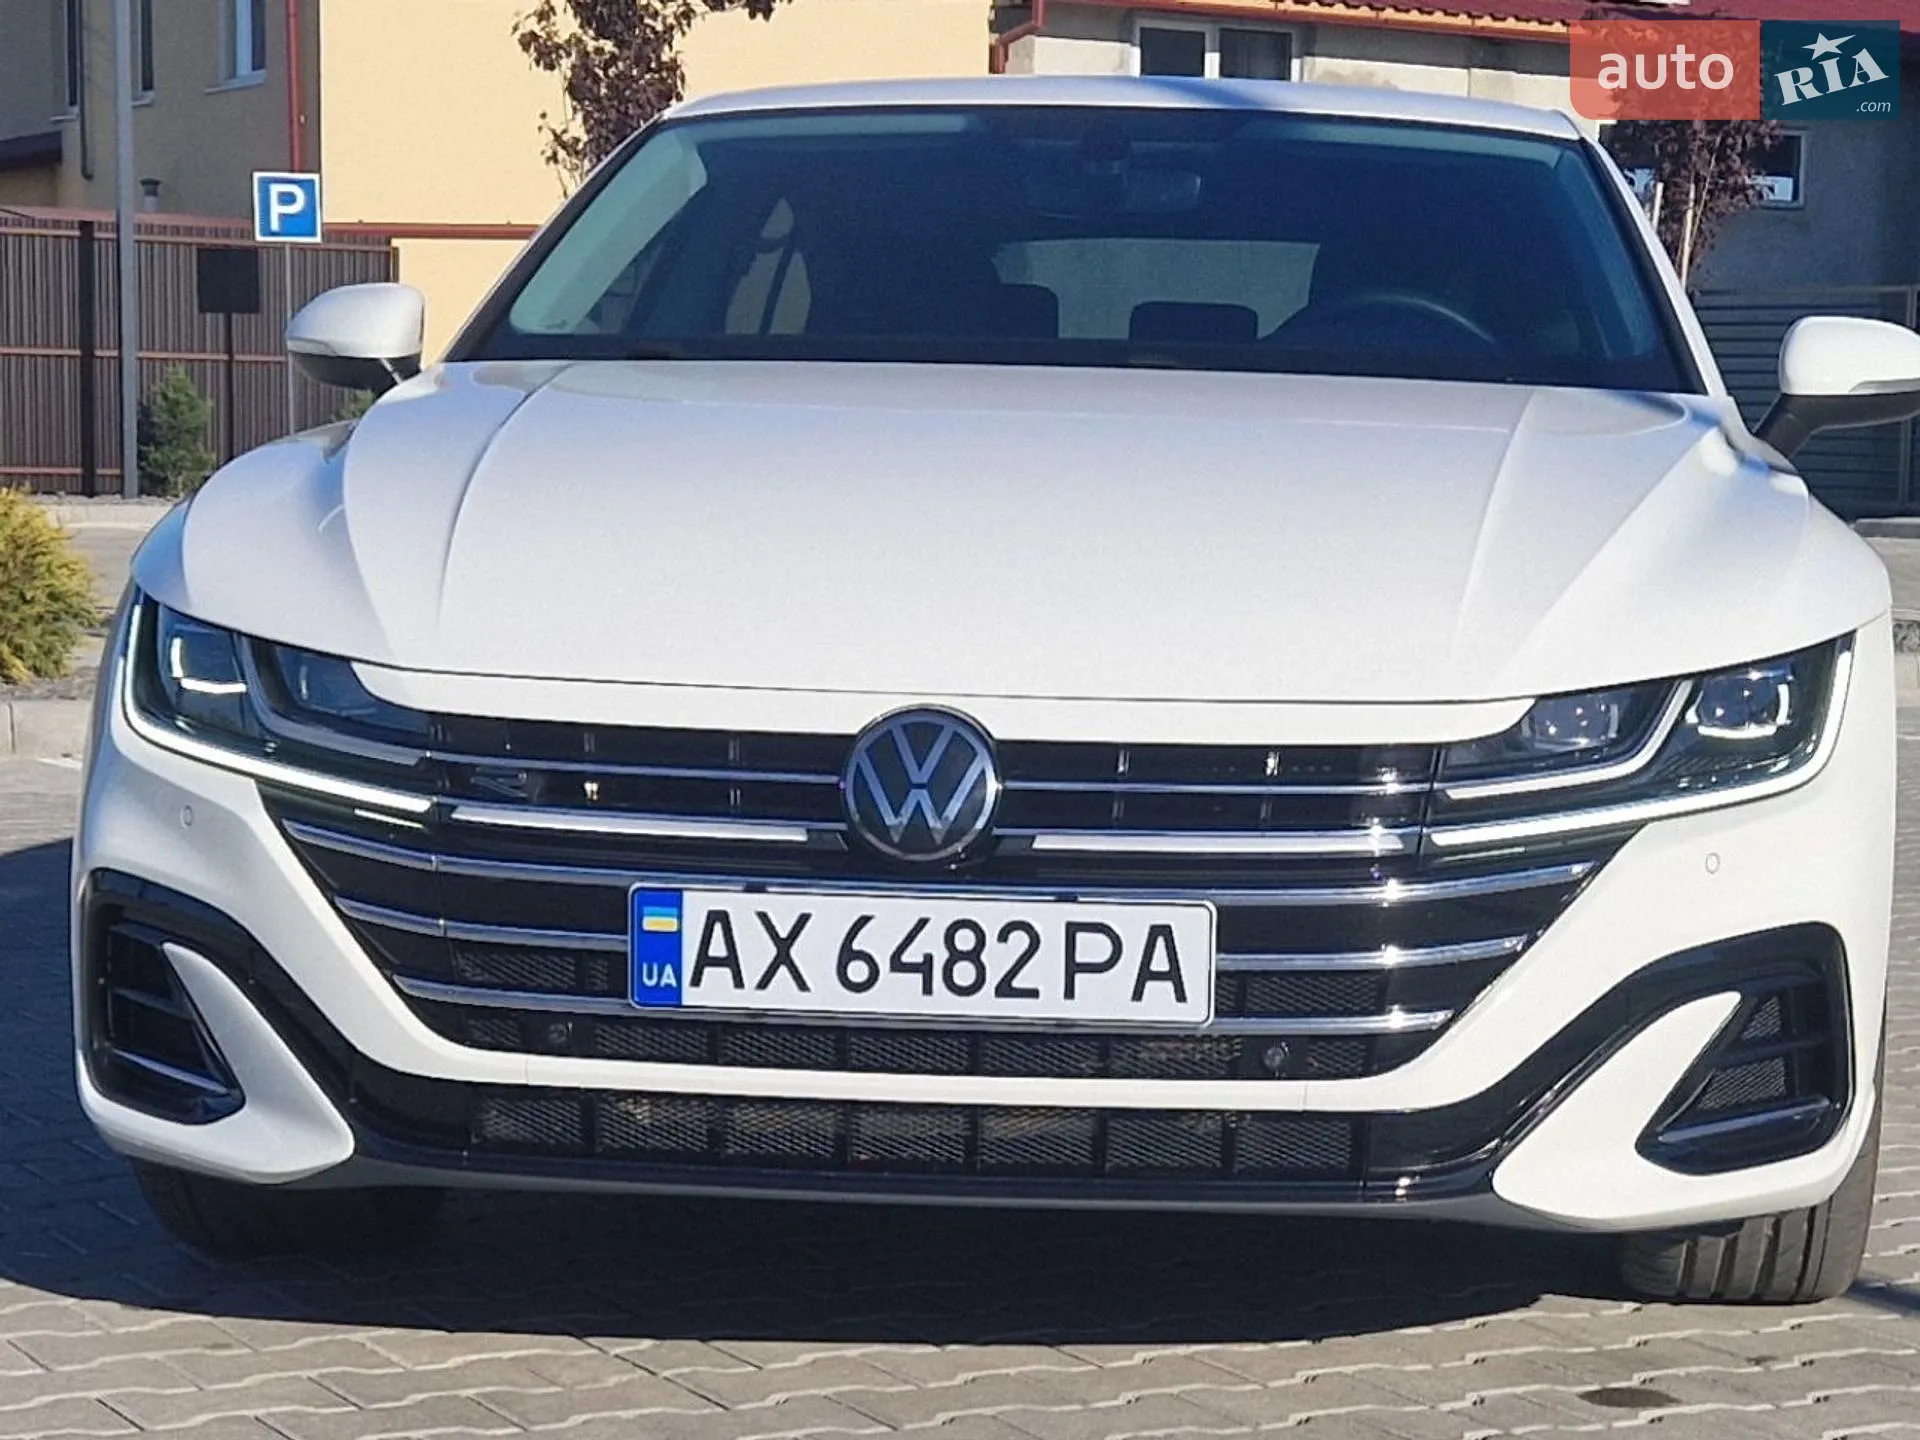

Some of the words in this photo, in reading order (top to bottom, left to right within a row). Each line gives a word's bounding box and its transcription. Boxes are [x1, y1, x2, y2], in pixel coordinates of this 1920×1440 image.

[269, 183, 305, 232] P
[642, 961, 678, 988] UA
[690, 909, 812, 992] AX
[836, 914, 1041, 999] 6482
[1063, 920, 1188, 1003] PA
